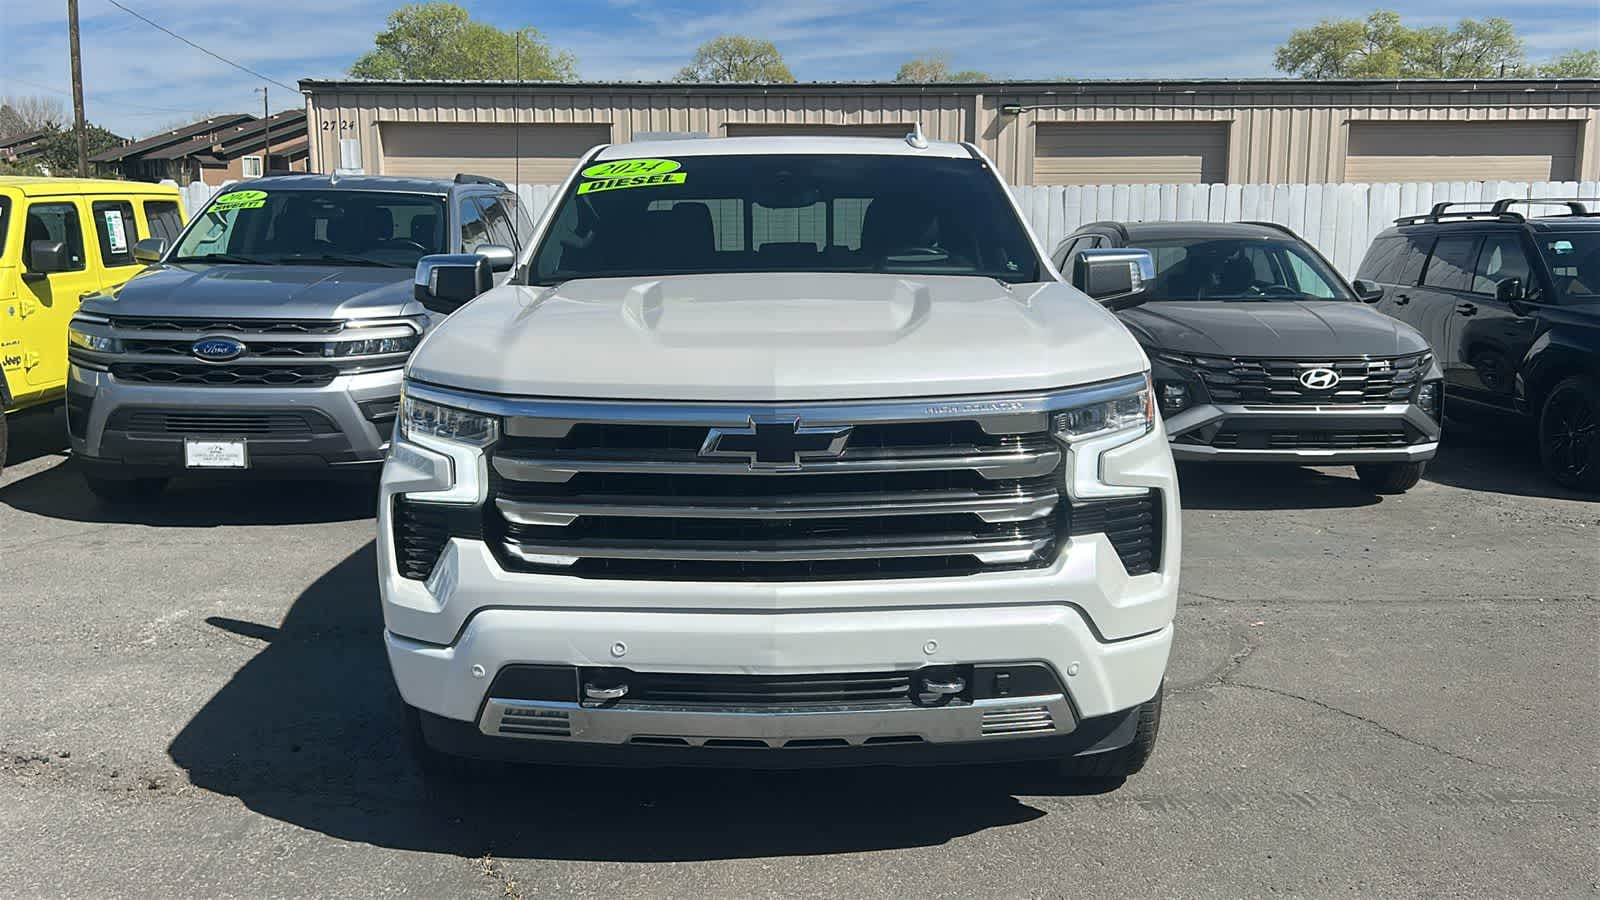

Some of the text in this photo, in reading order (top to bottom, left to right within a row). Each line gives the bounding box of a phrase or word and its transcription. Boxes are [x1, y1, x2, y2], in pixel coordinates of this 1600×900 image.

[593, 161, 665, 176] 2024
[588, 175, 676, 191] DIESEL
[2, 354, 21, 366] Jeep
